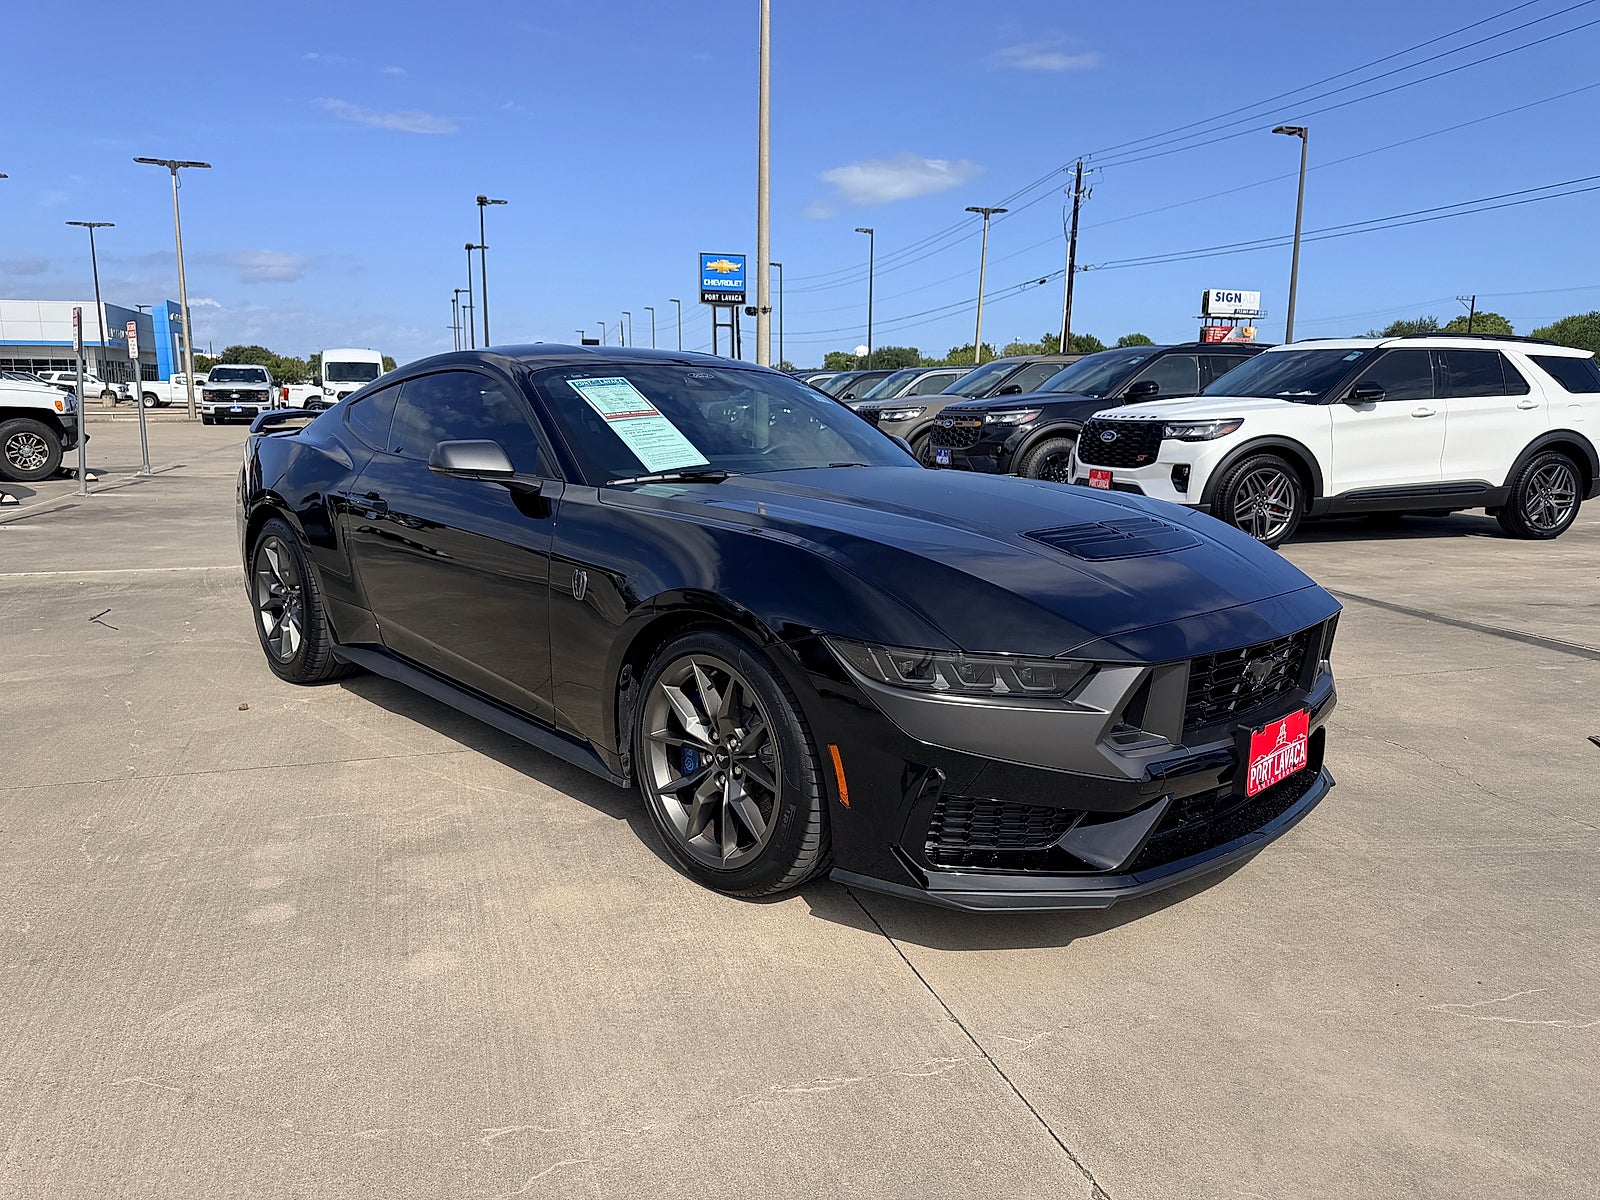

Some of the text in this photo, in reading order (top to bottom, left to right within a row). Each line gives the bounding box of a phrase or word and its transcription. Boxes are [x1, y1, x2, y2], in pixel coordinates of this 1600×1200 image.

[704, 278, 742, 287] CHEVROLET
[1250, 741, 1305, 788] PORT LAVACA
[1258, 778, 1274, 790] AUTO
